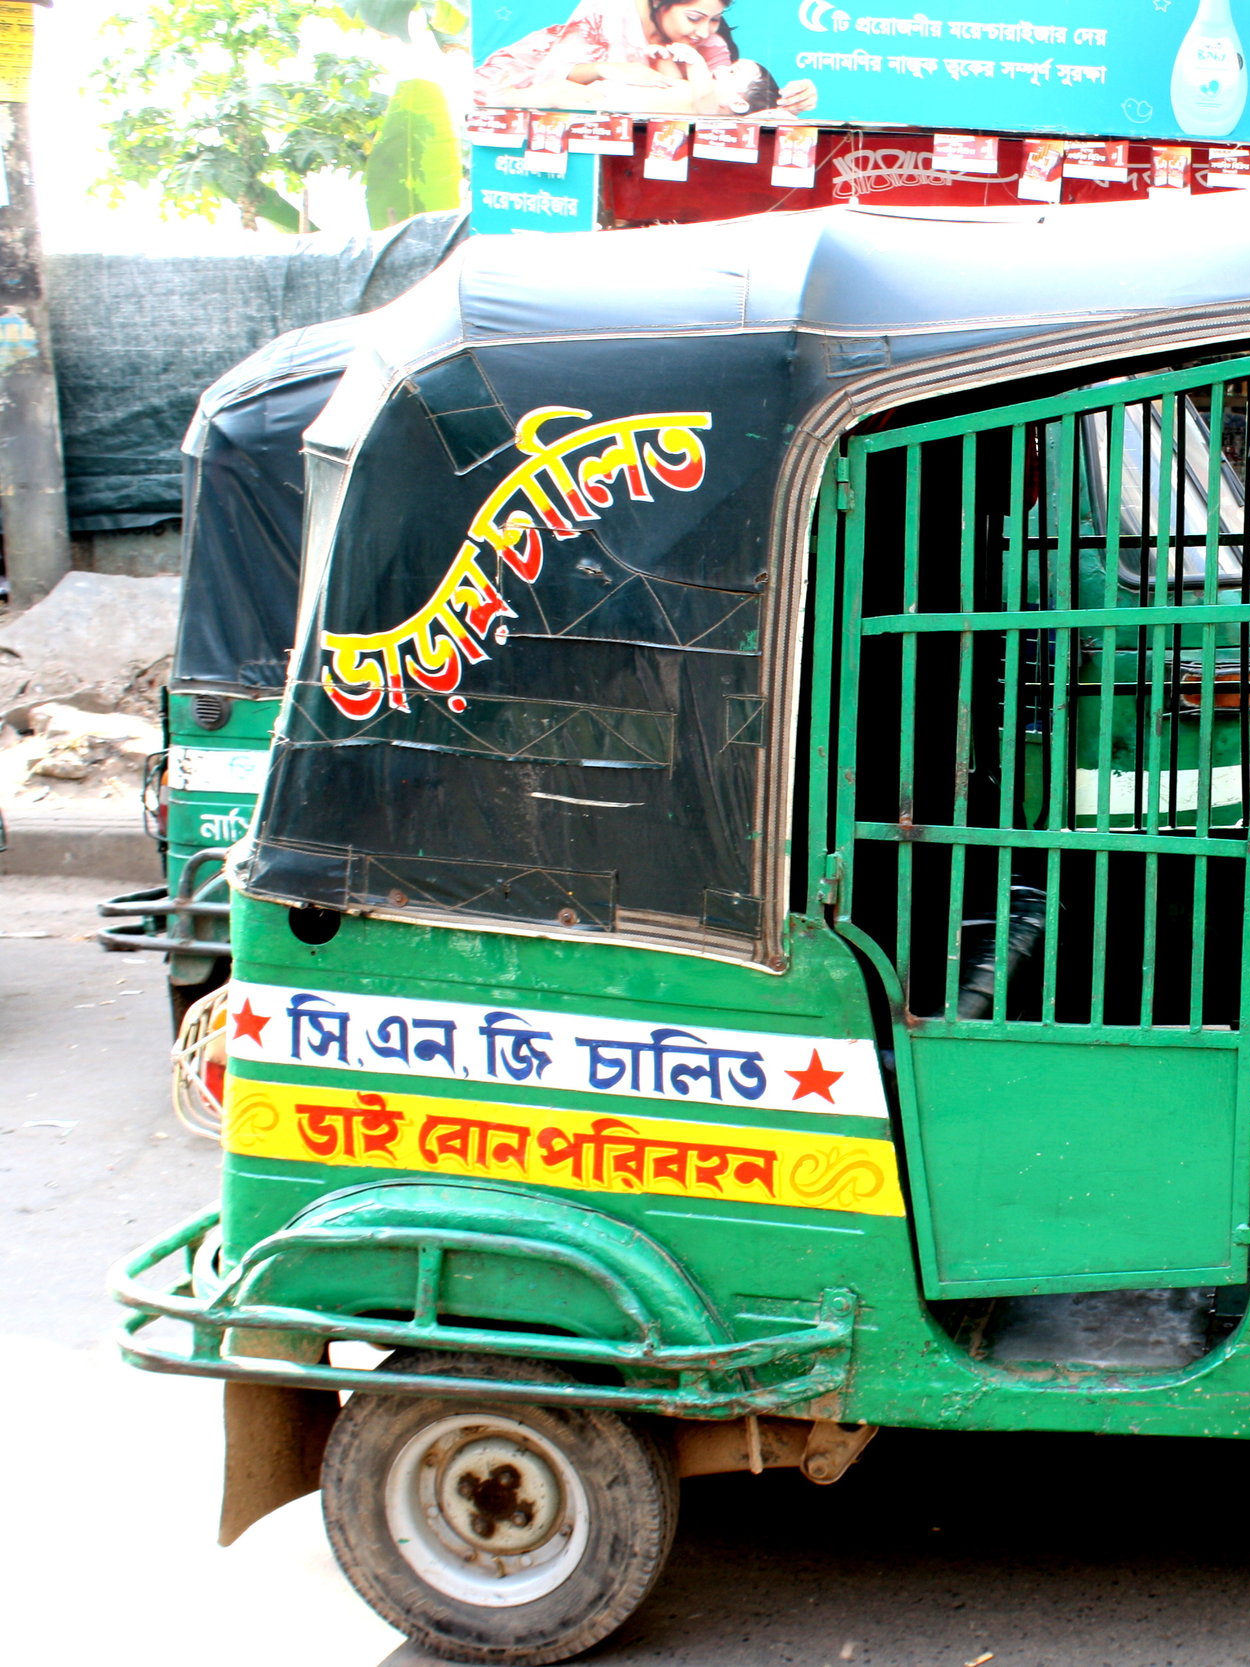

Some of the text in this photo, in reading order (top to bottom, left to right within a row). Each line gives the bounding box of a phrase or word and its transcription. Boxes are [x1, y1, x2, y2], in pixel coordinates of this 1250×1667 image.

[887, 56, 939, 78] নাজুক
[943, 59, 996, 81] ত্বকের
[1000, 59, 1054, 86] সম্পূর্ণ
[1074, 28, 1108, 46] দেয়
[321, 405, 713, 721] ভাড়ায় চালিত
[574, 1028, 767, 1101] চালিত
[295, 1091, 405, 1161] ভাই
